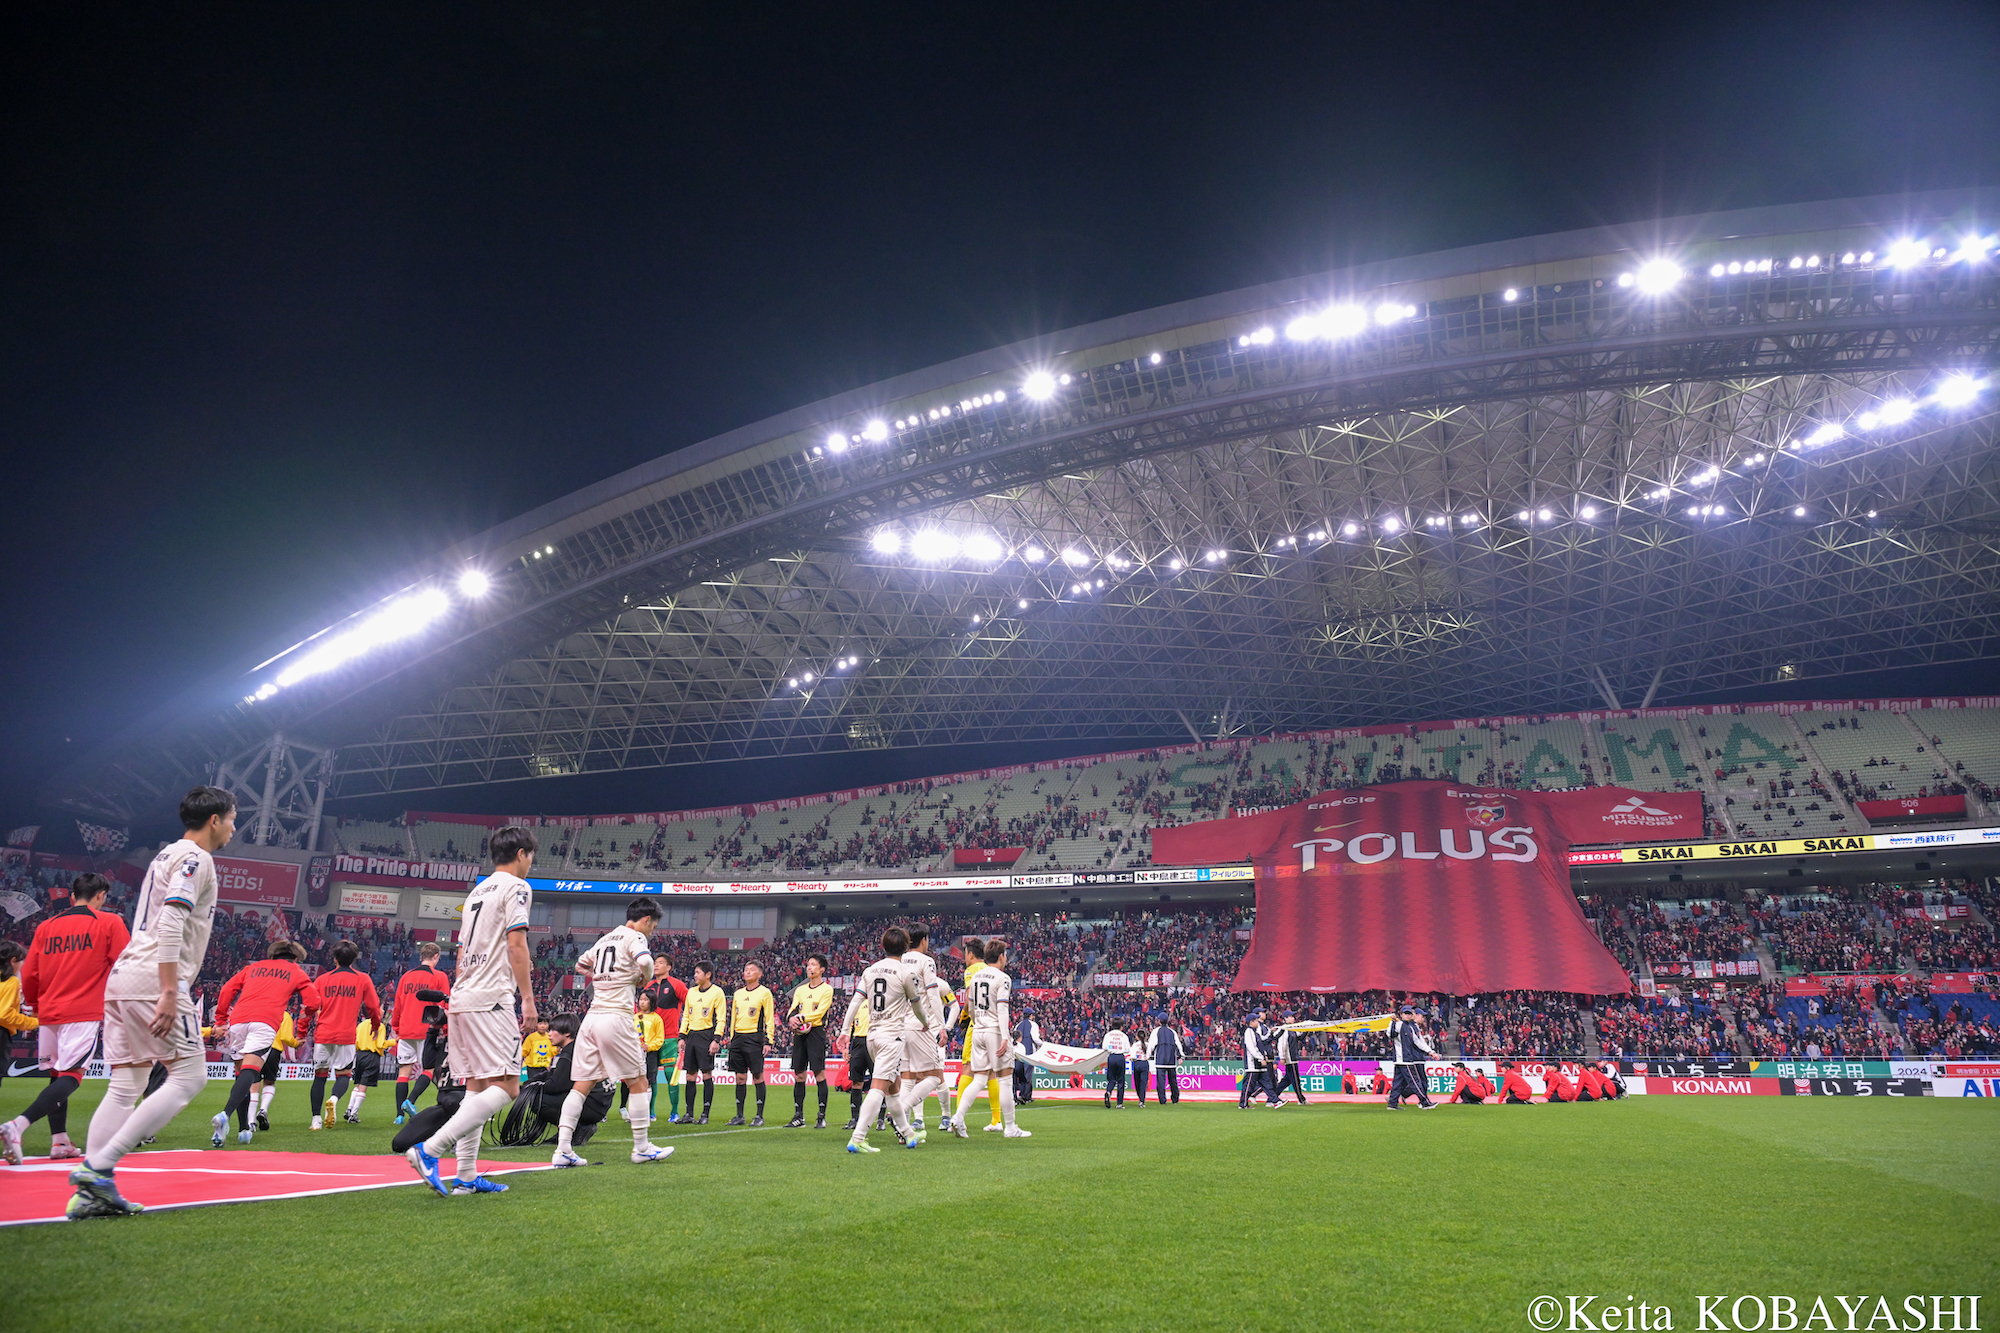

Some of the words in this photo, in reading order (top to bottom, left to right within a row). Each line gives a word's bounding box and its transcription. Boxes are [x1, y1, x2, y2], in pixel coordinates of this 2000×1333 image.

[1712, 705, 1731, 714] All
[1812, 700, 1853, 712] Hand
[1879, 699, 1922, 712] Hand
[1931, 698, 1959, 710] We
[1578, 712, 1600, 723] We
[1605, 712, 1628, 720] Are
[1453, 720, 1474, 729] We
[752, 803, 776, 813] Yes
[777, 799, 798, 810] We
[800, 795, 826, 806] Love
[1901, 799, 1919, 808] 506
[508, 817, 530, 826] We
[634, 814, 654, 824] We
[659, 812, 680, 822] Are
[1602, 814, 1683, 824] MITSUBISHI
[1614, 818, 1675, 828] MOTORS
[1292, 826, 1540, 872] POLUS
[1719, 844, 1777, 856] SAKAI
[1804, 838, 1864, 852] SAKAI
[1638, 848, 1693, 860] SAKAI
[214, 864, 229, 874] We
[231, 867, 248, 876] are
[336, 855, 364, 872] The
[367, 857, 408, 876] Pride
[410, 862, 426, 879] of
[428, 864, 482, 882] URAWA
[556, 882, 592, 891] サイボー
[618, 883, 654, 892] サイボー
[684, 884, 714, 894] Hearty
[741, 884, 771, 893] Hearty
[797, 882, 828, 892] Hearty
[466, 900, 483, 954] 7
[44, 932, 94, 955] URAWA
[593, 946, 616, 974] 10
[1694, 962, 1712, 970] 216
[251, 967, 292, 983] URAWA
[324, 985, 356, 998] URAWA
[874, 978, 886, 1012] 8
[974, 982, 990, 1010] 13
[182, 1014, 201, 1038] 11
[513, 1037, 520, 1058] 7
[1176, 1065, 1206, 1076] OUTE
[1658, 1063, 1734, 1078] いちご
[1777, 1064, 1864, 1078] 明治安田
[1898, 1068, 1927, 1076] 2024
[1672, 1080, 1752, 1094] KONAMI
[1821, 1080, 1905, 1096] いちご
